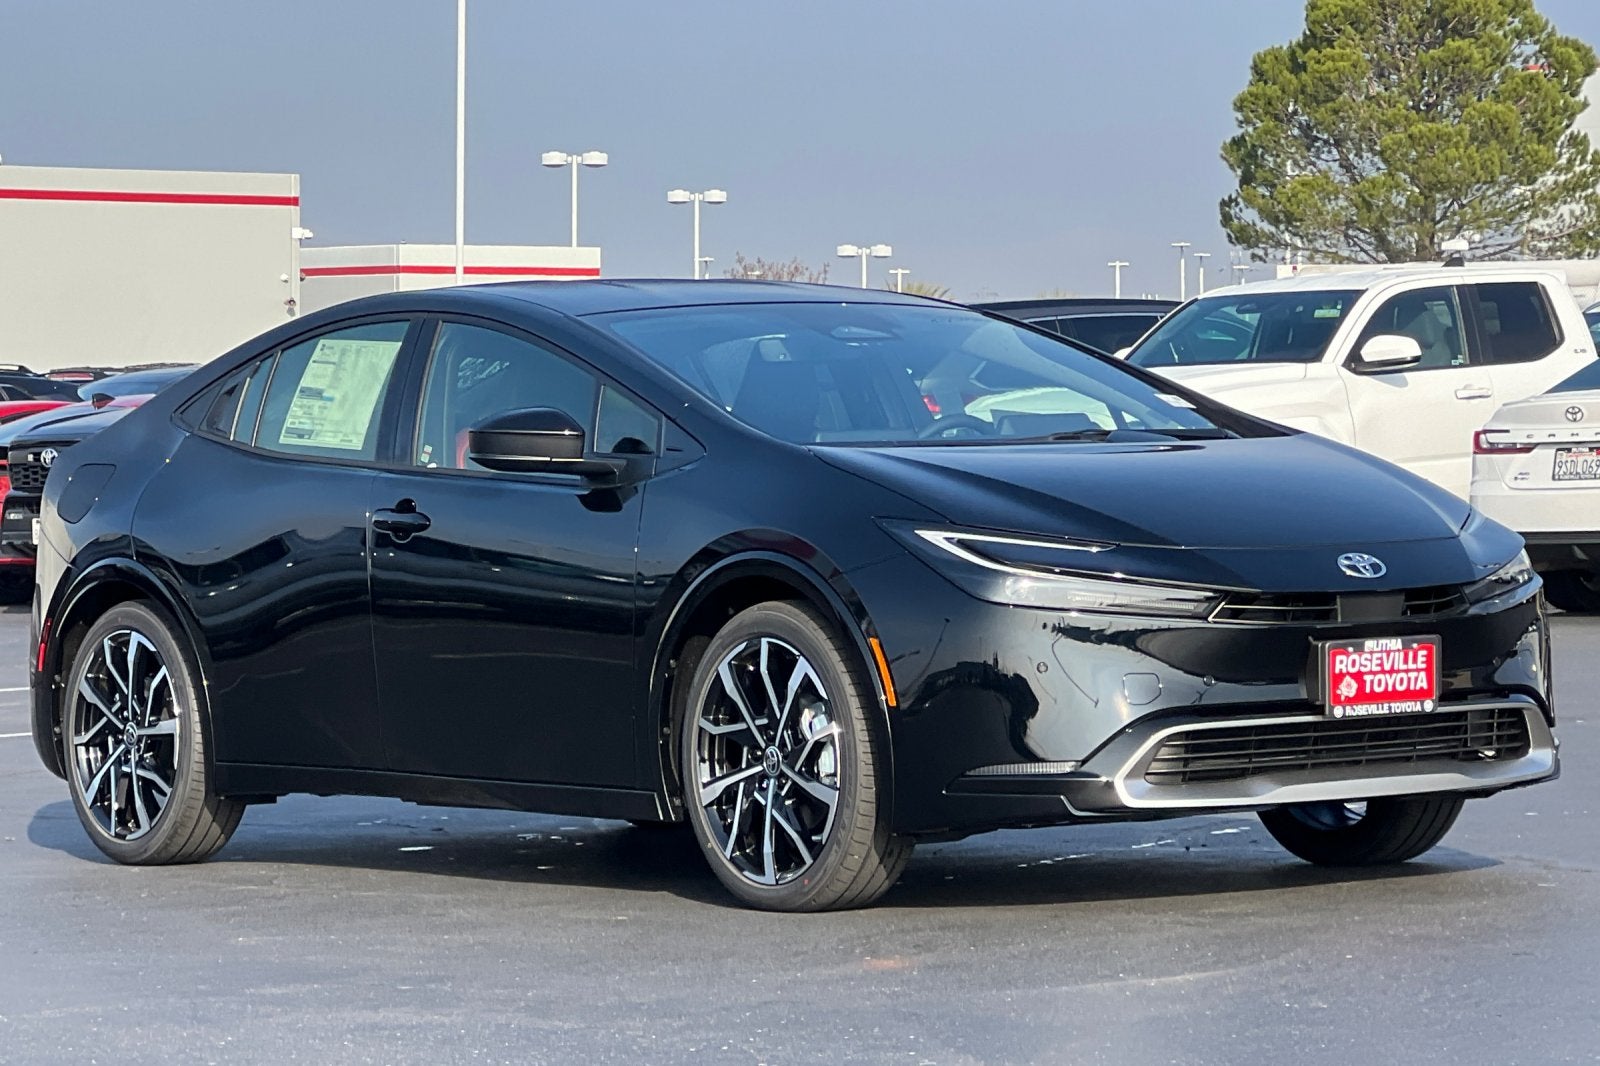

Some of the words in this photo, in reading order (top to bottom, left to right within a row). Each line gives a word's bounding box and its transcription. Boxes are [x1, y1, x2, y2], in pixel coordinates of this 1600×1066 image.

[1374, 638, 1403, 651] LITHIA
[1335, 650, 1428, 674] ROSEVILLE
[1363, 671, 1428, 694] TOYOTA
[1345, 703, 1390, 717] ROSEVILLE
[1390, 701, 1422, 714] TOYOTA
